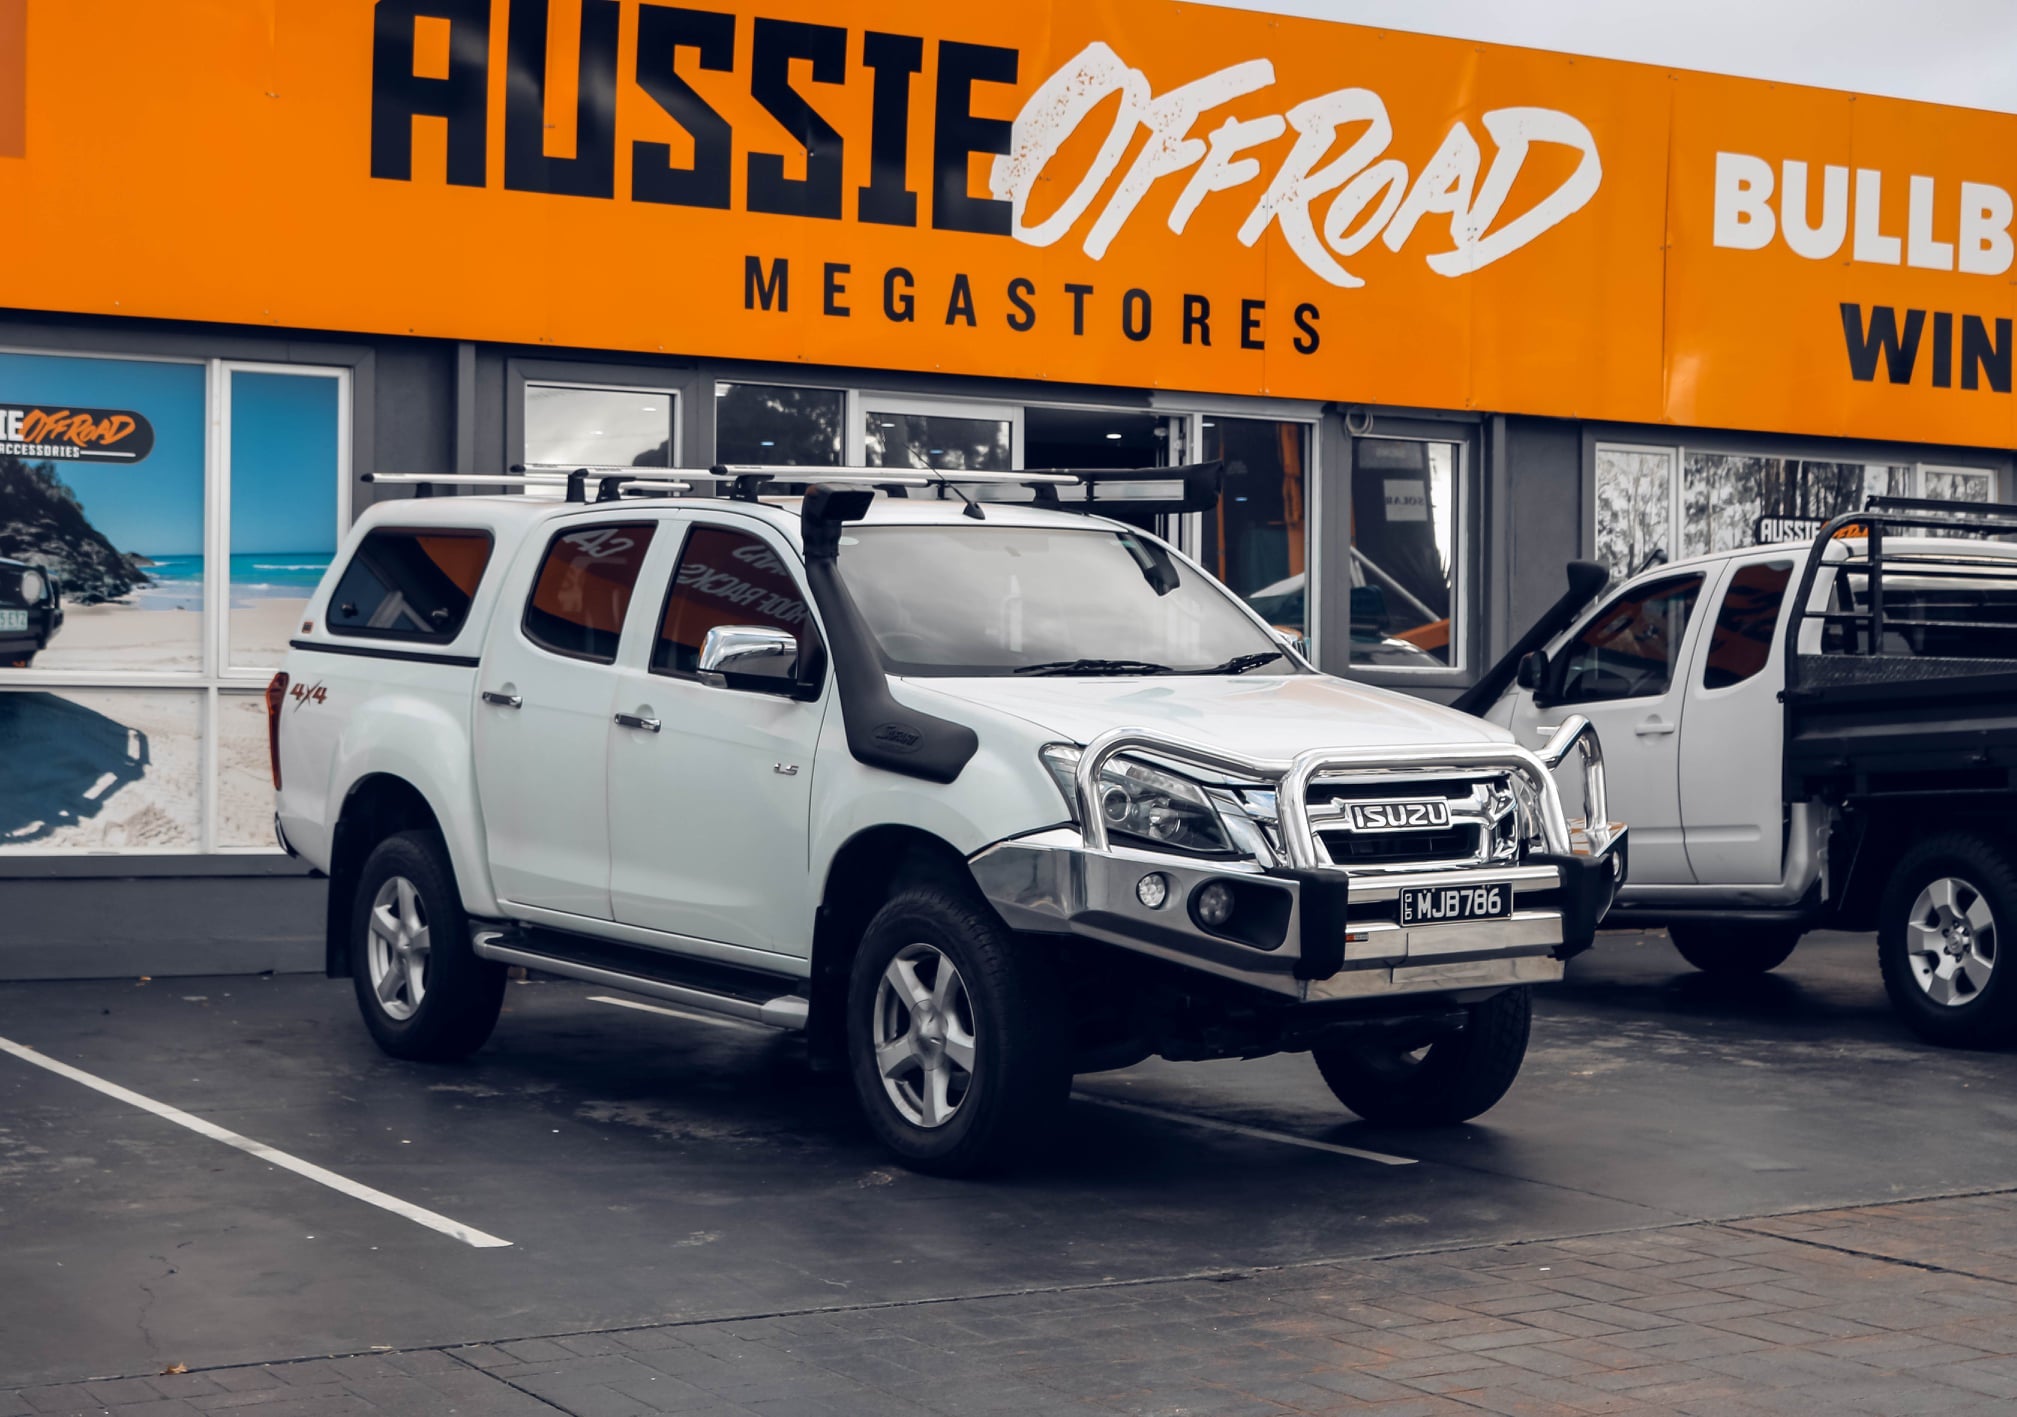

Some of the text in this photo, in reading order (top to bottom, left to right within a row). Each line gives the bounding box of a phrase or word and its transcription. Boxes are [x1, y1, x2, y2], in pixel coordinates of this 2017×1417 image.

[371, 0, 1019, 236] AUSSIE
[1713, 151, 2015, 276] BULLB
[744, 255, 1321, 355] MEGASTORES
[1839, 302, 2013, 393] WIN
[1354, 804, 1448, 828] ISUZU
[1417, 888, 1502, 919] MJB786
